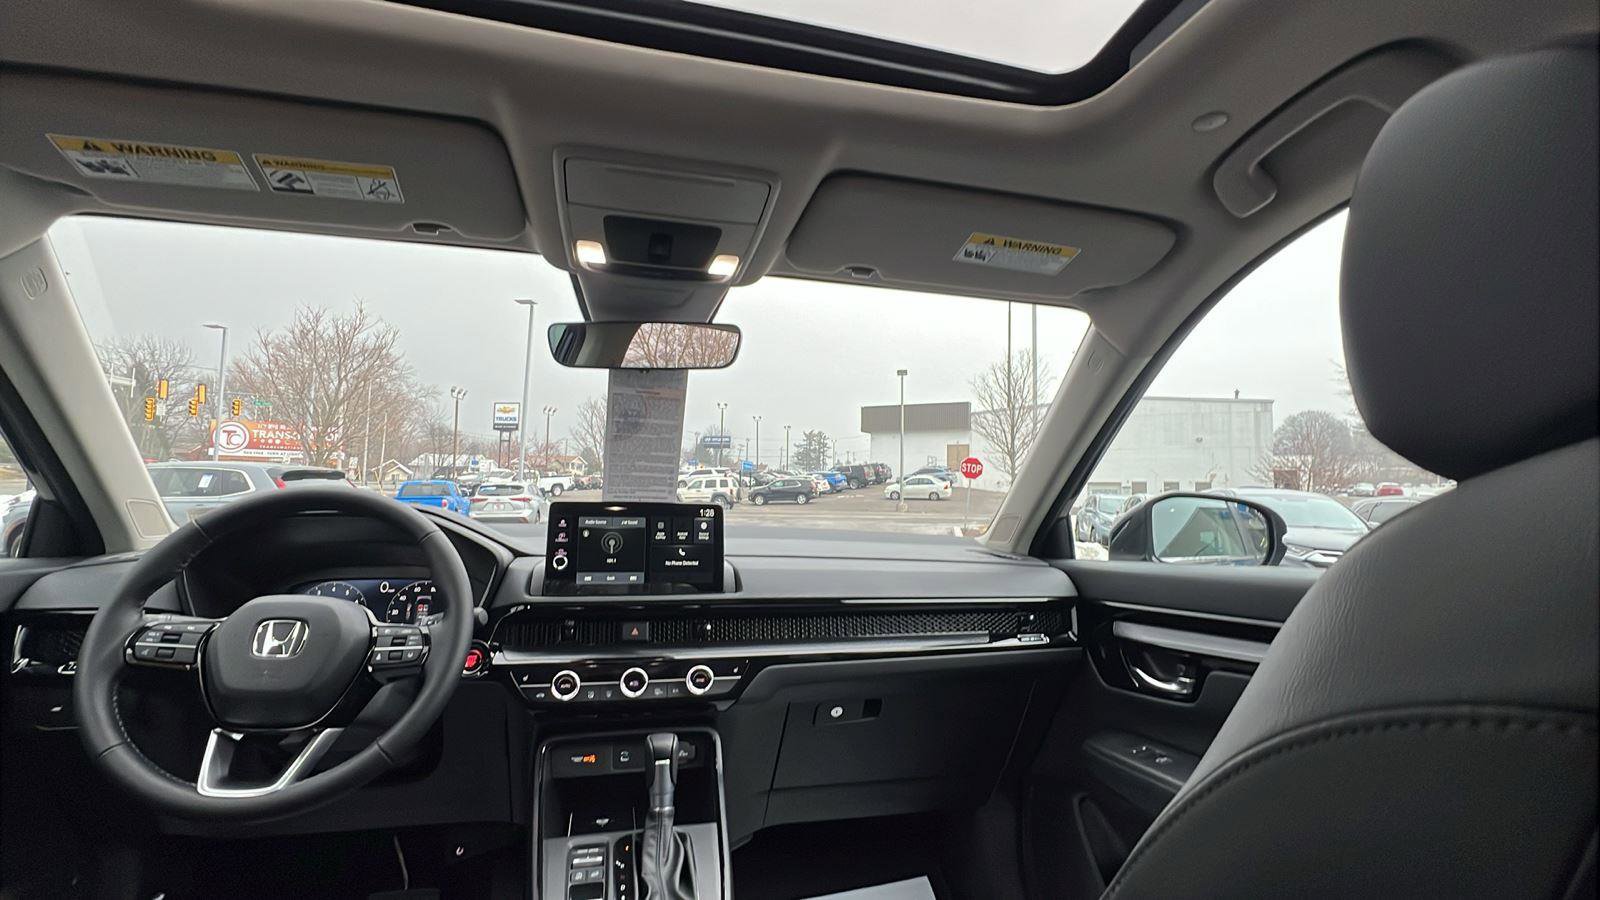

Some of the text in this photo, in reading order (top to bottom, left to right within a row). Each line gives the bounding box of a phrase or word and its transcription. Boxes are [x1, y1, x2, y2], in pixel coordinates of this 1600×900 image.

[110, 142, 217, 162] WARNING
[1003, 239, 1062, 255] WARNING
[961, 462, 982, 473] STOP
[380, 581, 389, 593] 0
